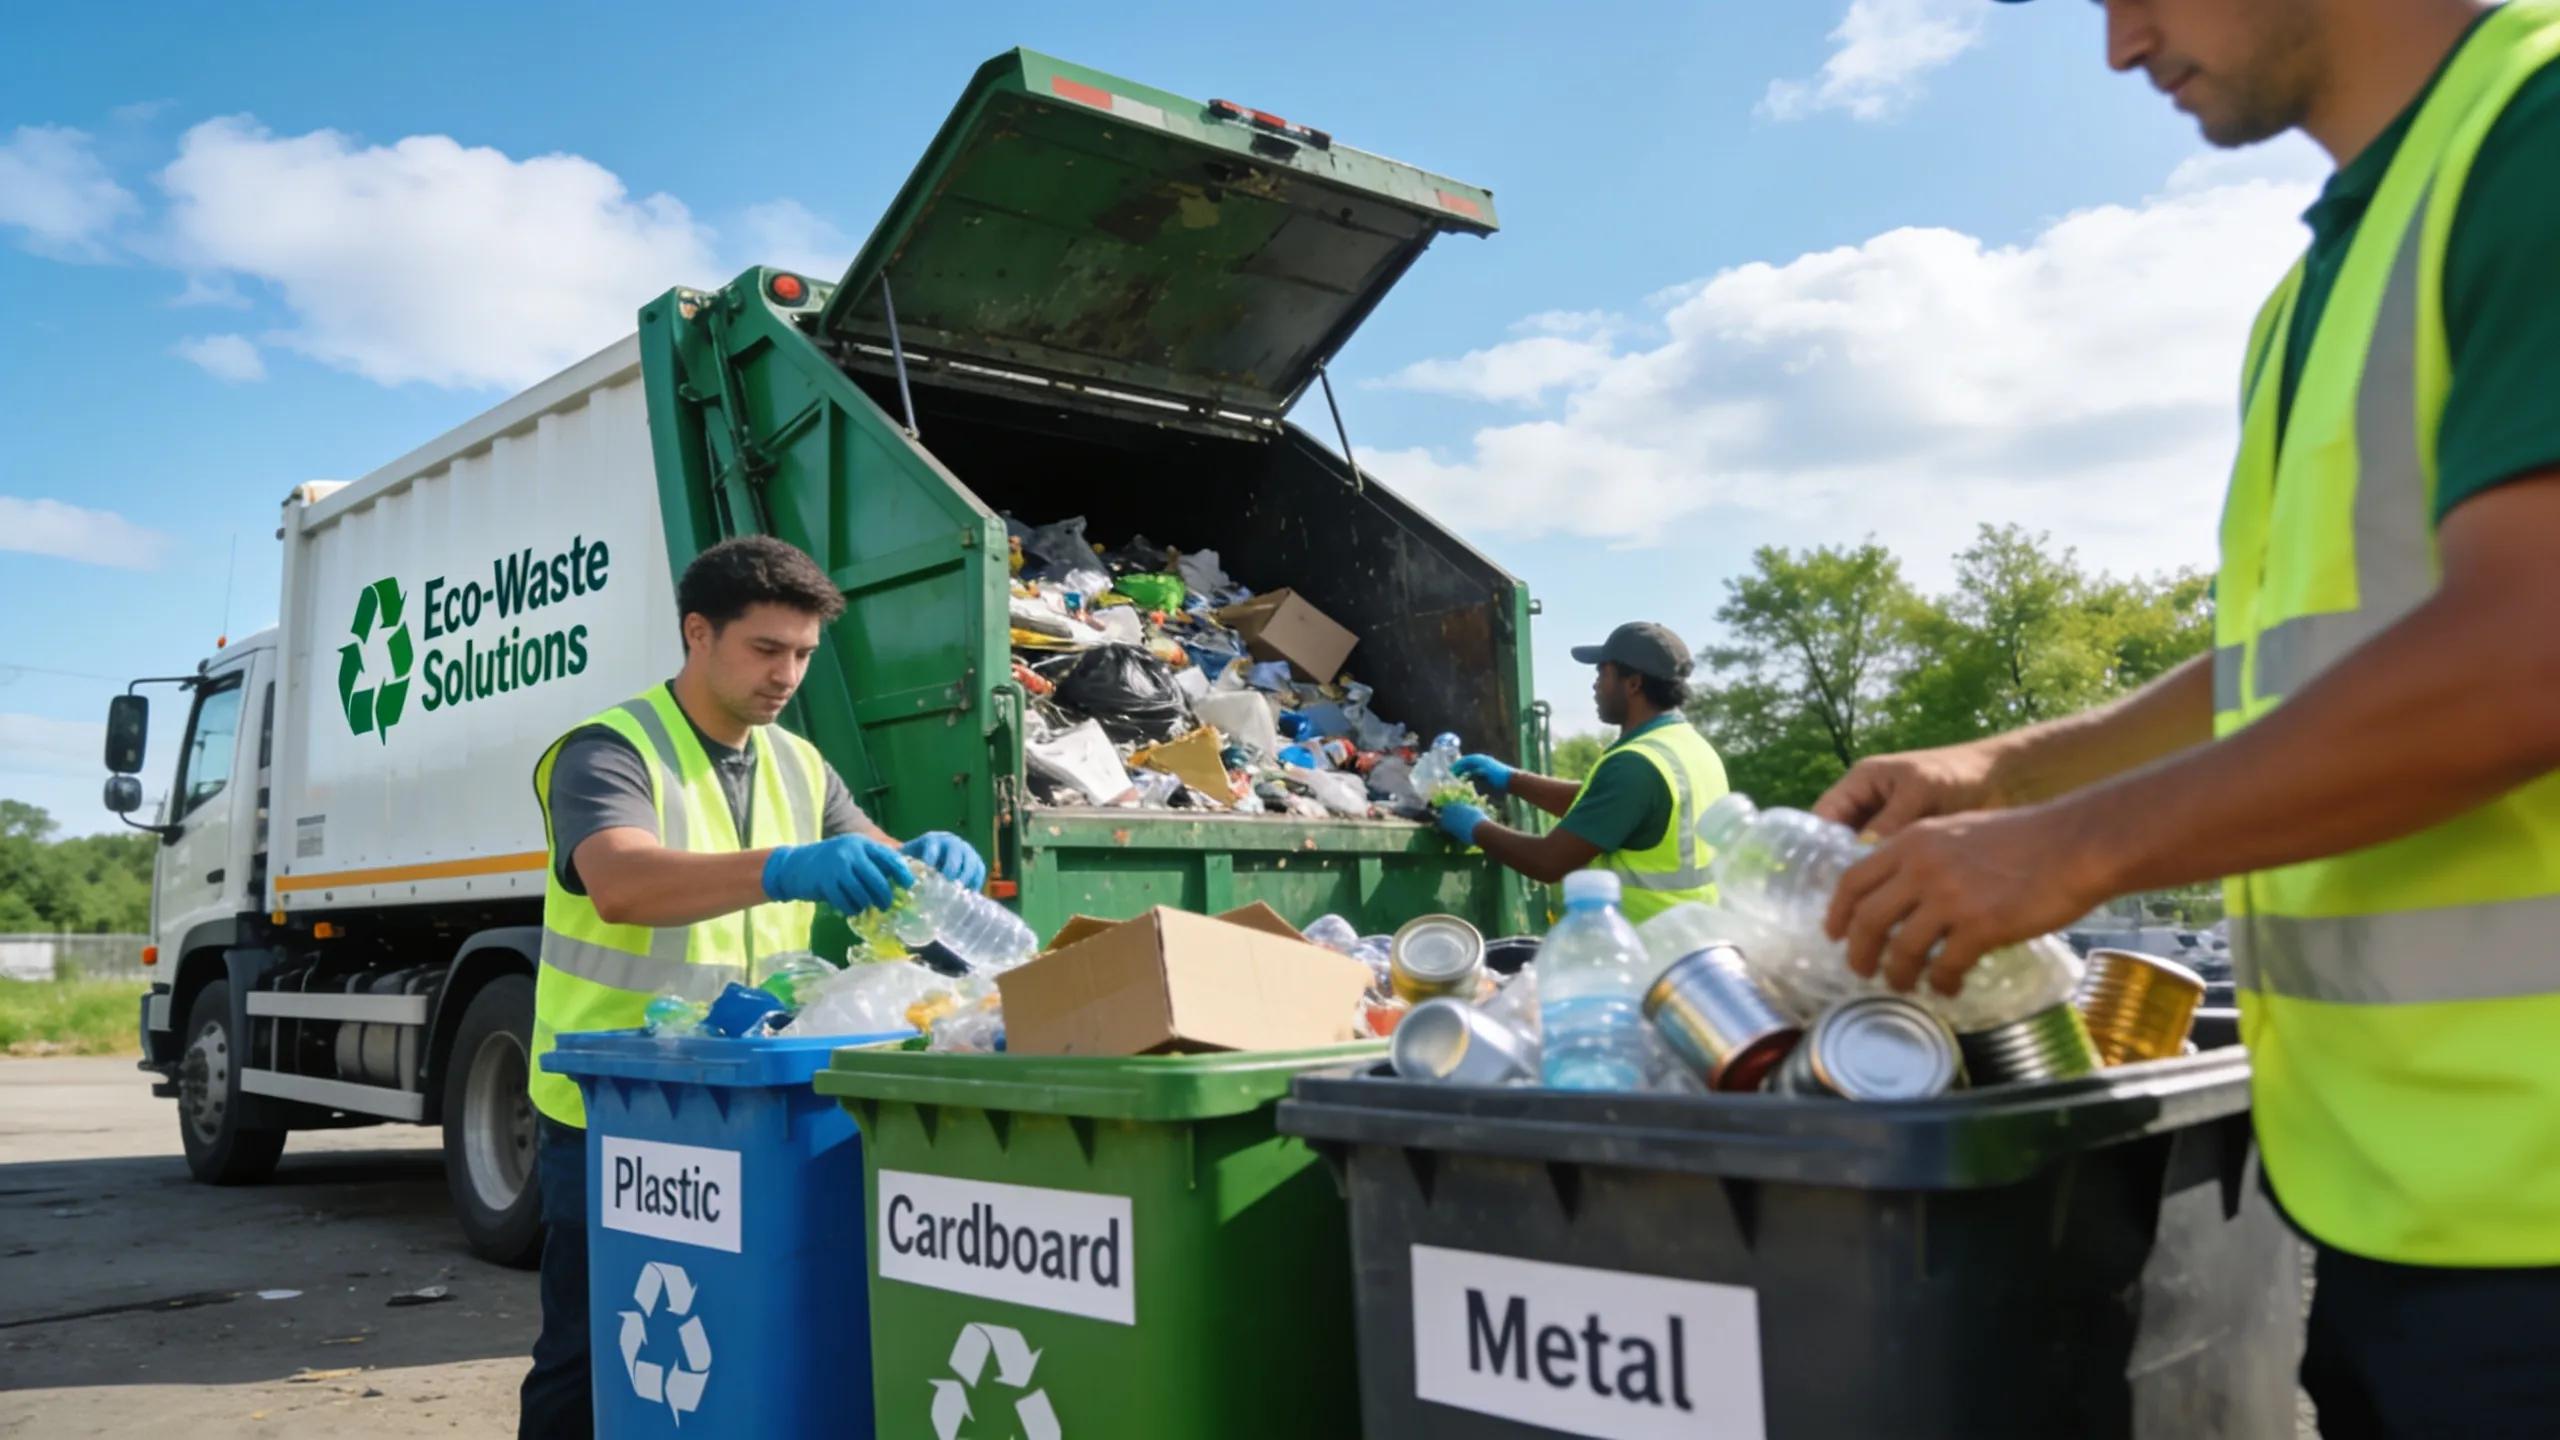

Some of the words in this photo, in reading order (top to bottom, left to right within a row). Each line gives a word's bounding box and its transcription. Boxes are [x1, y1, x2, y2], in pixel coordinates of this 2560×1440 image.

[424, 534, 609, 641] Eco-Waste
[421, 624, 588, 712] Solutions
[614, 1156, 720, 1223] Plastic
[888, 1194, 1120, 1288] Cardboard
[1465, 1287, 1694, 1413] Metal
